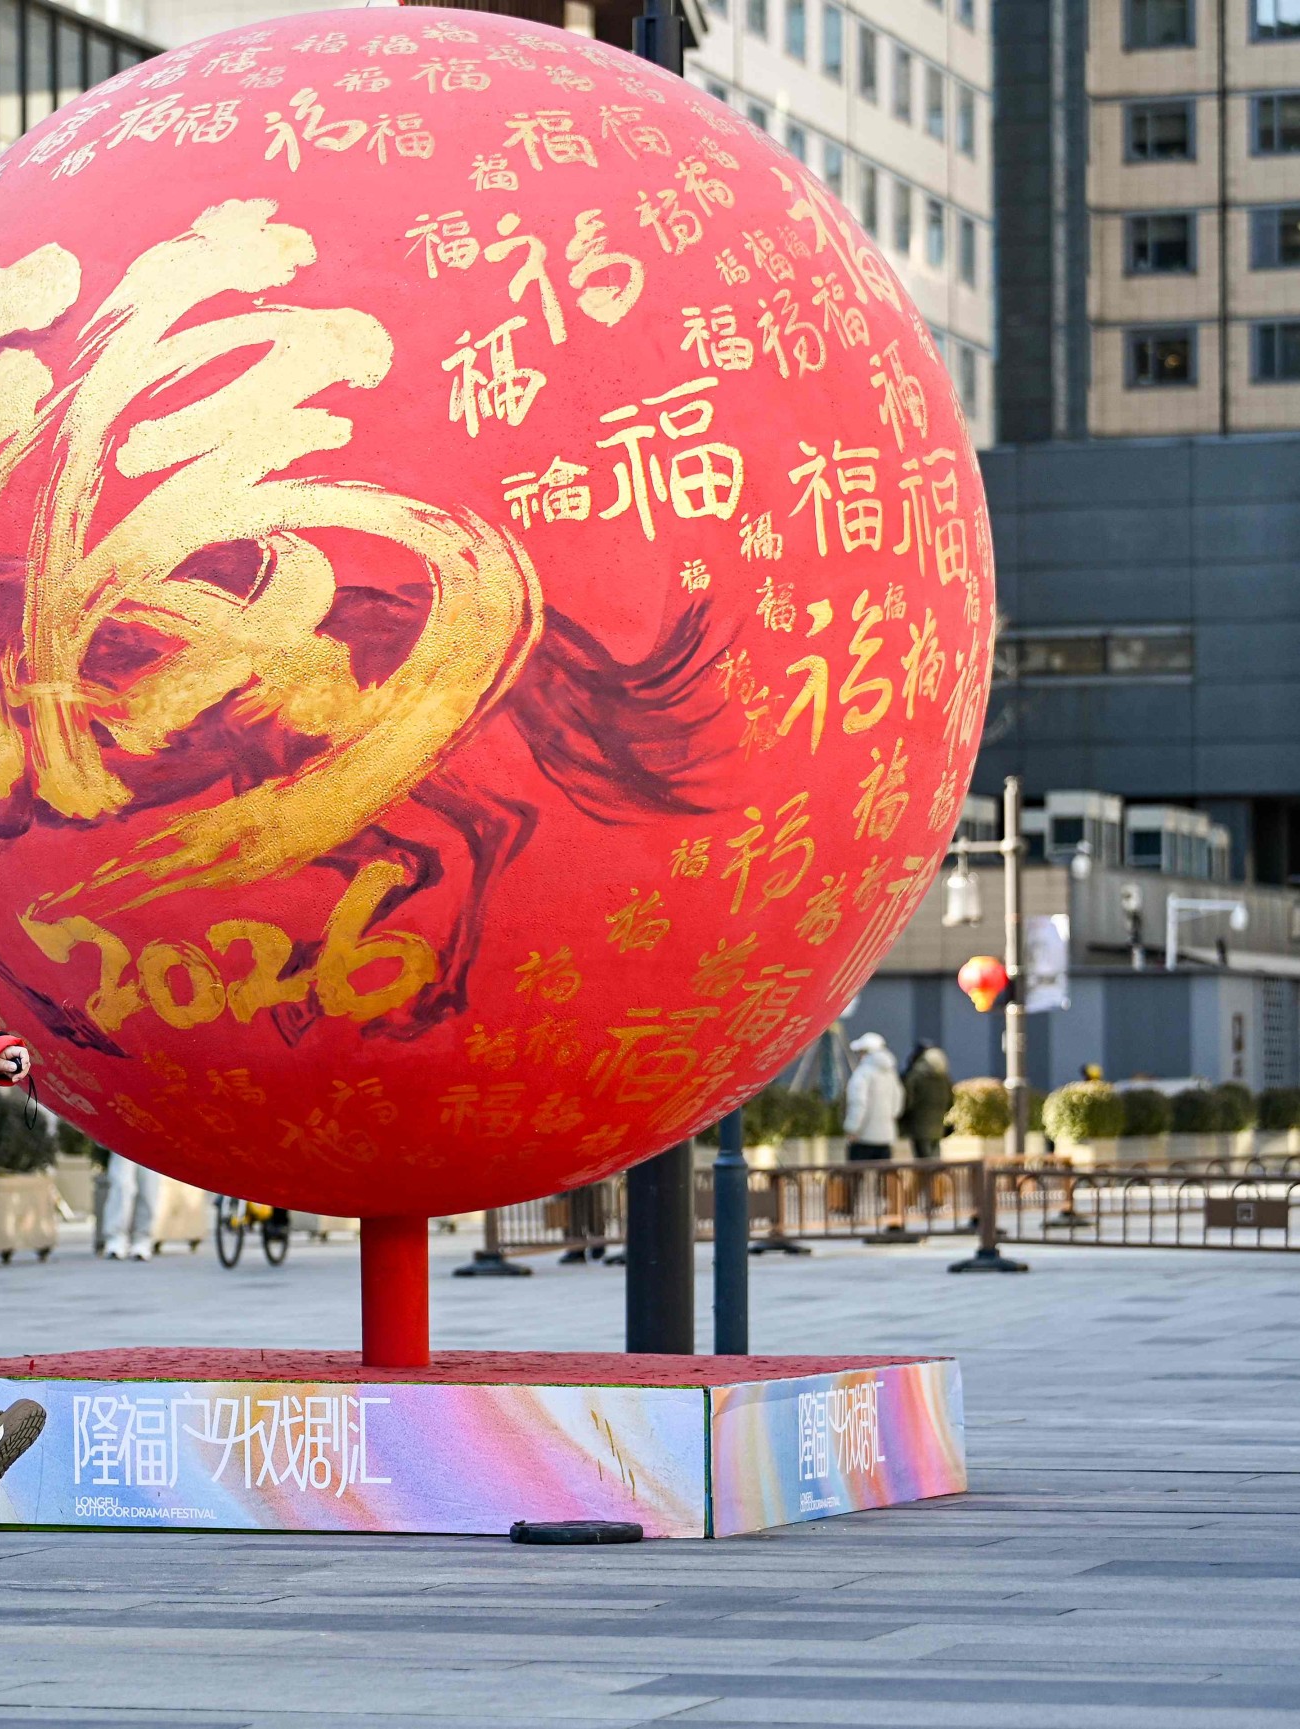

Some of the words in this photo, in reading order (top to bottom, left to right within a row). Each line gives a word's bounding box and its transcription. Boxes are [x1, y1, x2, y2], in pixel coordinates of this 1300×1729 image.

[200, 47, 273, 77] 福
[291, 32, 348, 54] 福
[359, 35, 419, 56] 福
[333, 66, 392, 92] 福
[410, 58, 491, 94] 福
[102, 93, 184, 149] 福
[173, 99, 242, 147] 福
[263, 87, 369, 173] 福
[366, 113, 435, 165] 福
[502, 110, 598, 172] 福
[599, 104, 672, 161] 福
[51, 140, 100, 181] 福
[468, 153, 519, 192] 福
[675, 156, 735, 218] 福
[405, 211, 479, 279] 福
[634, 189, 703, 255] 福
[483, 208, 645, 346] 福
[715, 248, 751, 286] 福
[742, 230, 795, 284] 福
[680, 305, 754, 371] 福
[757, 289, 827, 379] 福
[811, 272, 870, 350] 福
[441, 315, 546, 438] 福
[869, 339, 928, 453] 福
[596, 376, 745, 541] 福
[788, 439, 882, 557] 福
[893, 448, 967, 586] 福
[739, 510, 783, 563] 福
[680, 559, 711, 594] 福
[756, 576, 797, 633] 福
[884, 582, 908, 621] 福
[776, 589, 893, 756] 福
[900, 608, 946, 721] 福
[853, 737, 910, 841] 福
[669, 836, 713, 878] 福
[720, 791, 815, 915] 福
[17, 860, 440, 1031] 2026
[606, 887, 671, 953] 福
[515, 945, 583, 1004] 福
[725, 964, 813, 1046] 福
[586, 1006, 721, 1104] 福
[328, 1077, 398, 1126] 福
[437, 1081, 526, 1138] 福
[73, 1394, 392, 1499] 隆福户外戏剧汇
[75, 1496, 119, 1508] LONGFU
[75, 1505, 130, 1518] OUTDOOR
[131, 1507, 170, 1518] DRAMA
[170, 1507, 217, 1520] FESTIVAL
